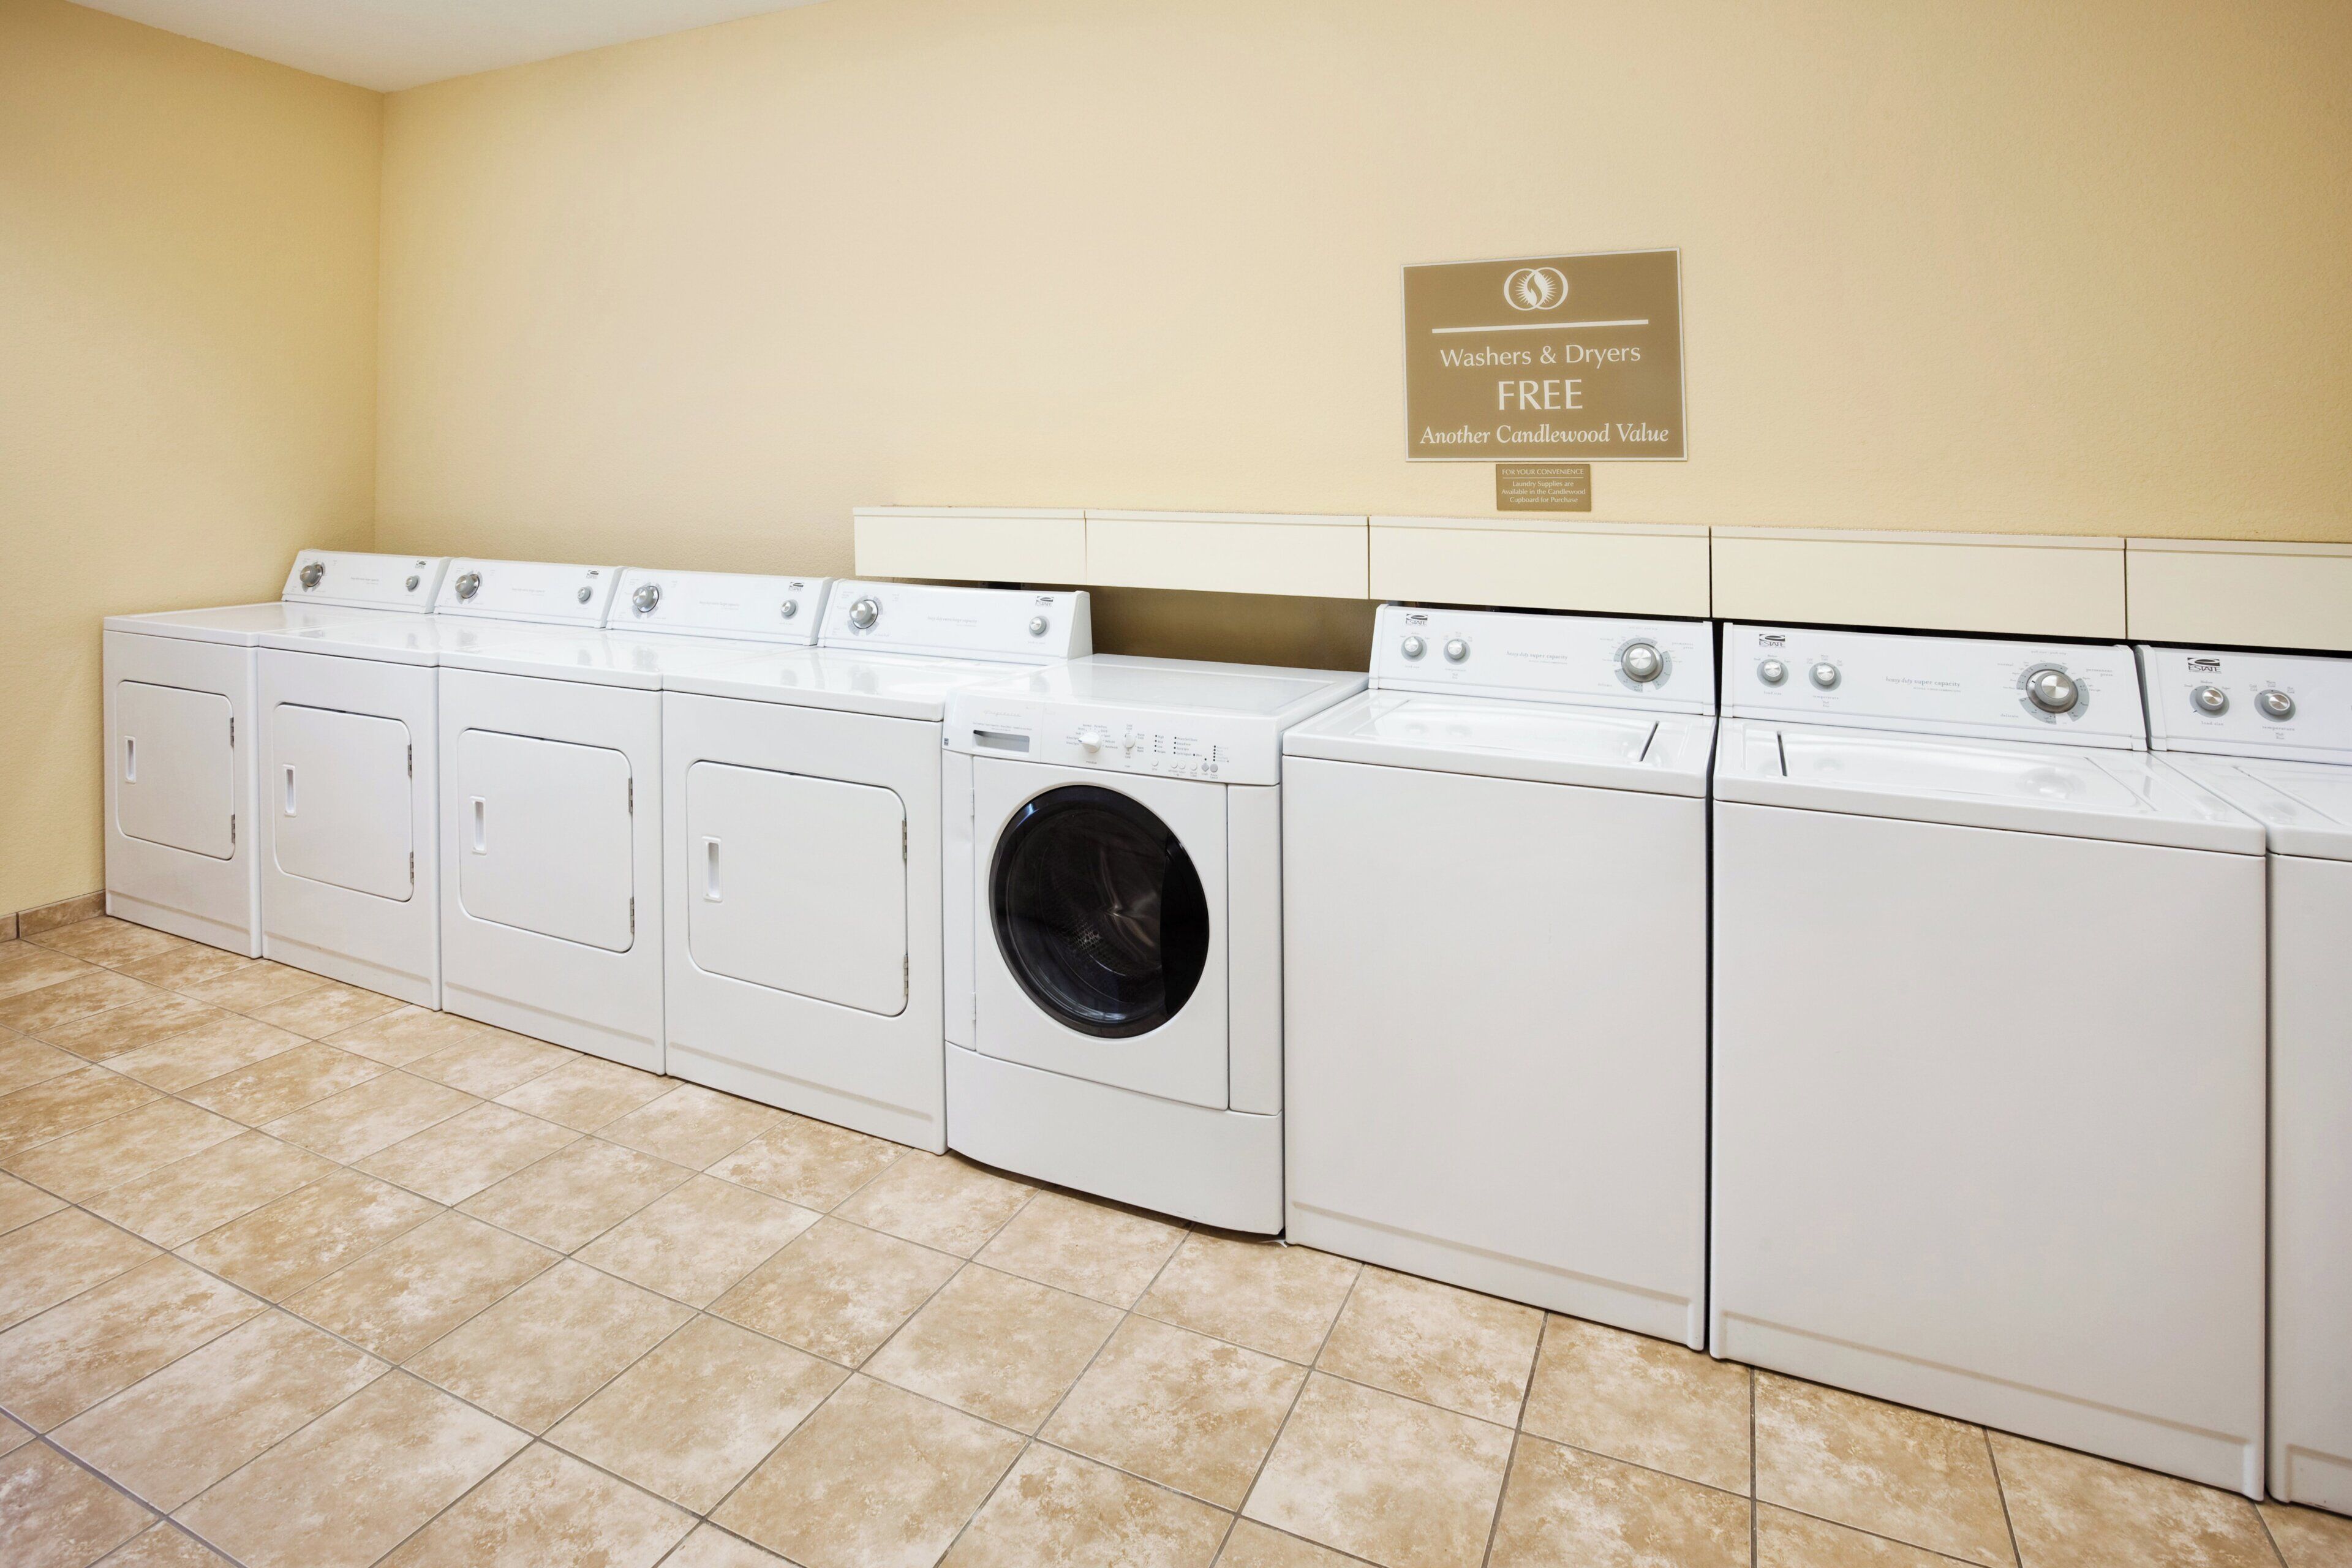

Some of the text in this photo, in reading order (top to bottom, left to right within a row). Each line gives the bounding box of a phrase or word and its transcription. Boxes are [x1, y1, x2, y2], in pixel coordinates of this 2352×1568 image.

[1439, 344, 1642, 369] Washers & Dryers
[1498, 379, 1583, 410] FREE
[1419, 422, 1669, 444] Another Candlewood Value
[1885, 676, 1900, 684] heavy
